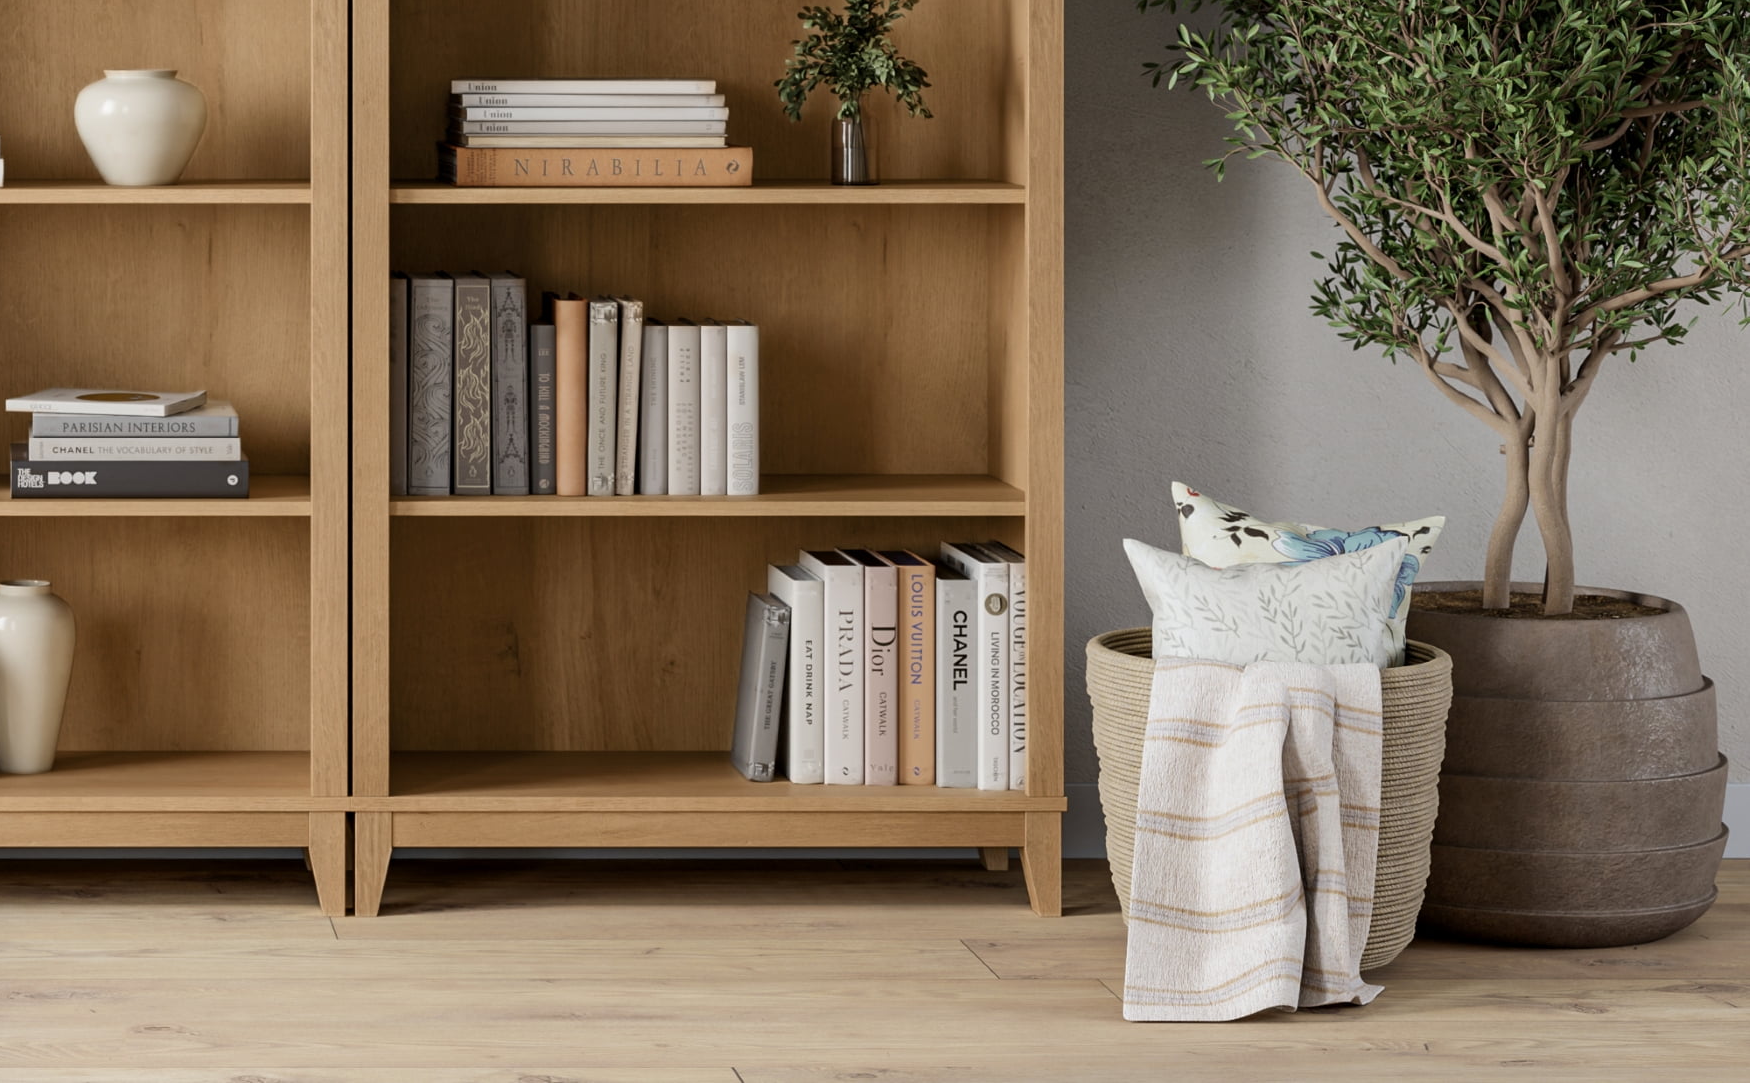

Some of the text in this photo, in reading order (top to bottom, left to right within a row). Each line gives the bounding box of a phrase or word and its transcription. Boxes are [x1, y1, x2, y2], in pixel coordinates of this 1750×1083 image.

[468, 82, 497, 92] Union
[478, 96, 508, 105] Union
[484, 110, 512, 119] Union
[480, 124, 508, 132] Union
[538, 374, 550, 382] TO
[538, 386, 550, 400] KILL
[62, 422, 196, 433] PARISIAN INTERIORS
[598, 429, 606, 452] ONCE
[52, 446, 214, 454] CHANEL THE VOCABULARY OF STYLE
[732, 422, 754, 491] SOLARIS
[48, 472, 97, 484] BOOK
[911, 574, 923, 685] LOUIS VUITTON
[838, 610, 854, 692] PRADA
[953, 610, 968, 690] CHANEL
[872, 622, 896, 736] Dior CATWALK
[991, 632, 1000, 735] LIVING IN MOROCCO
